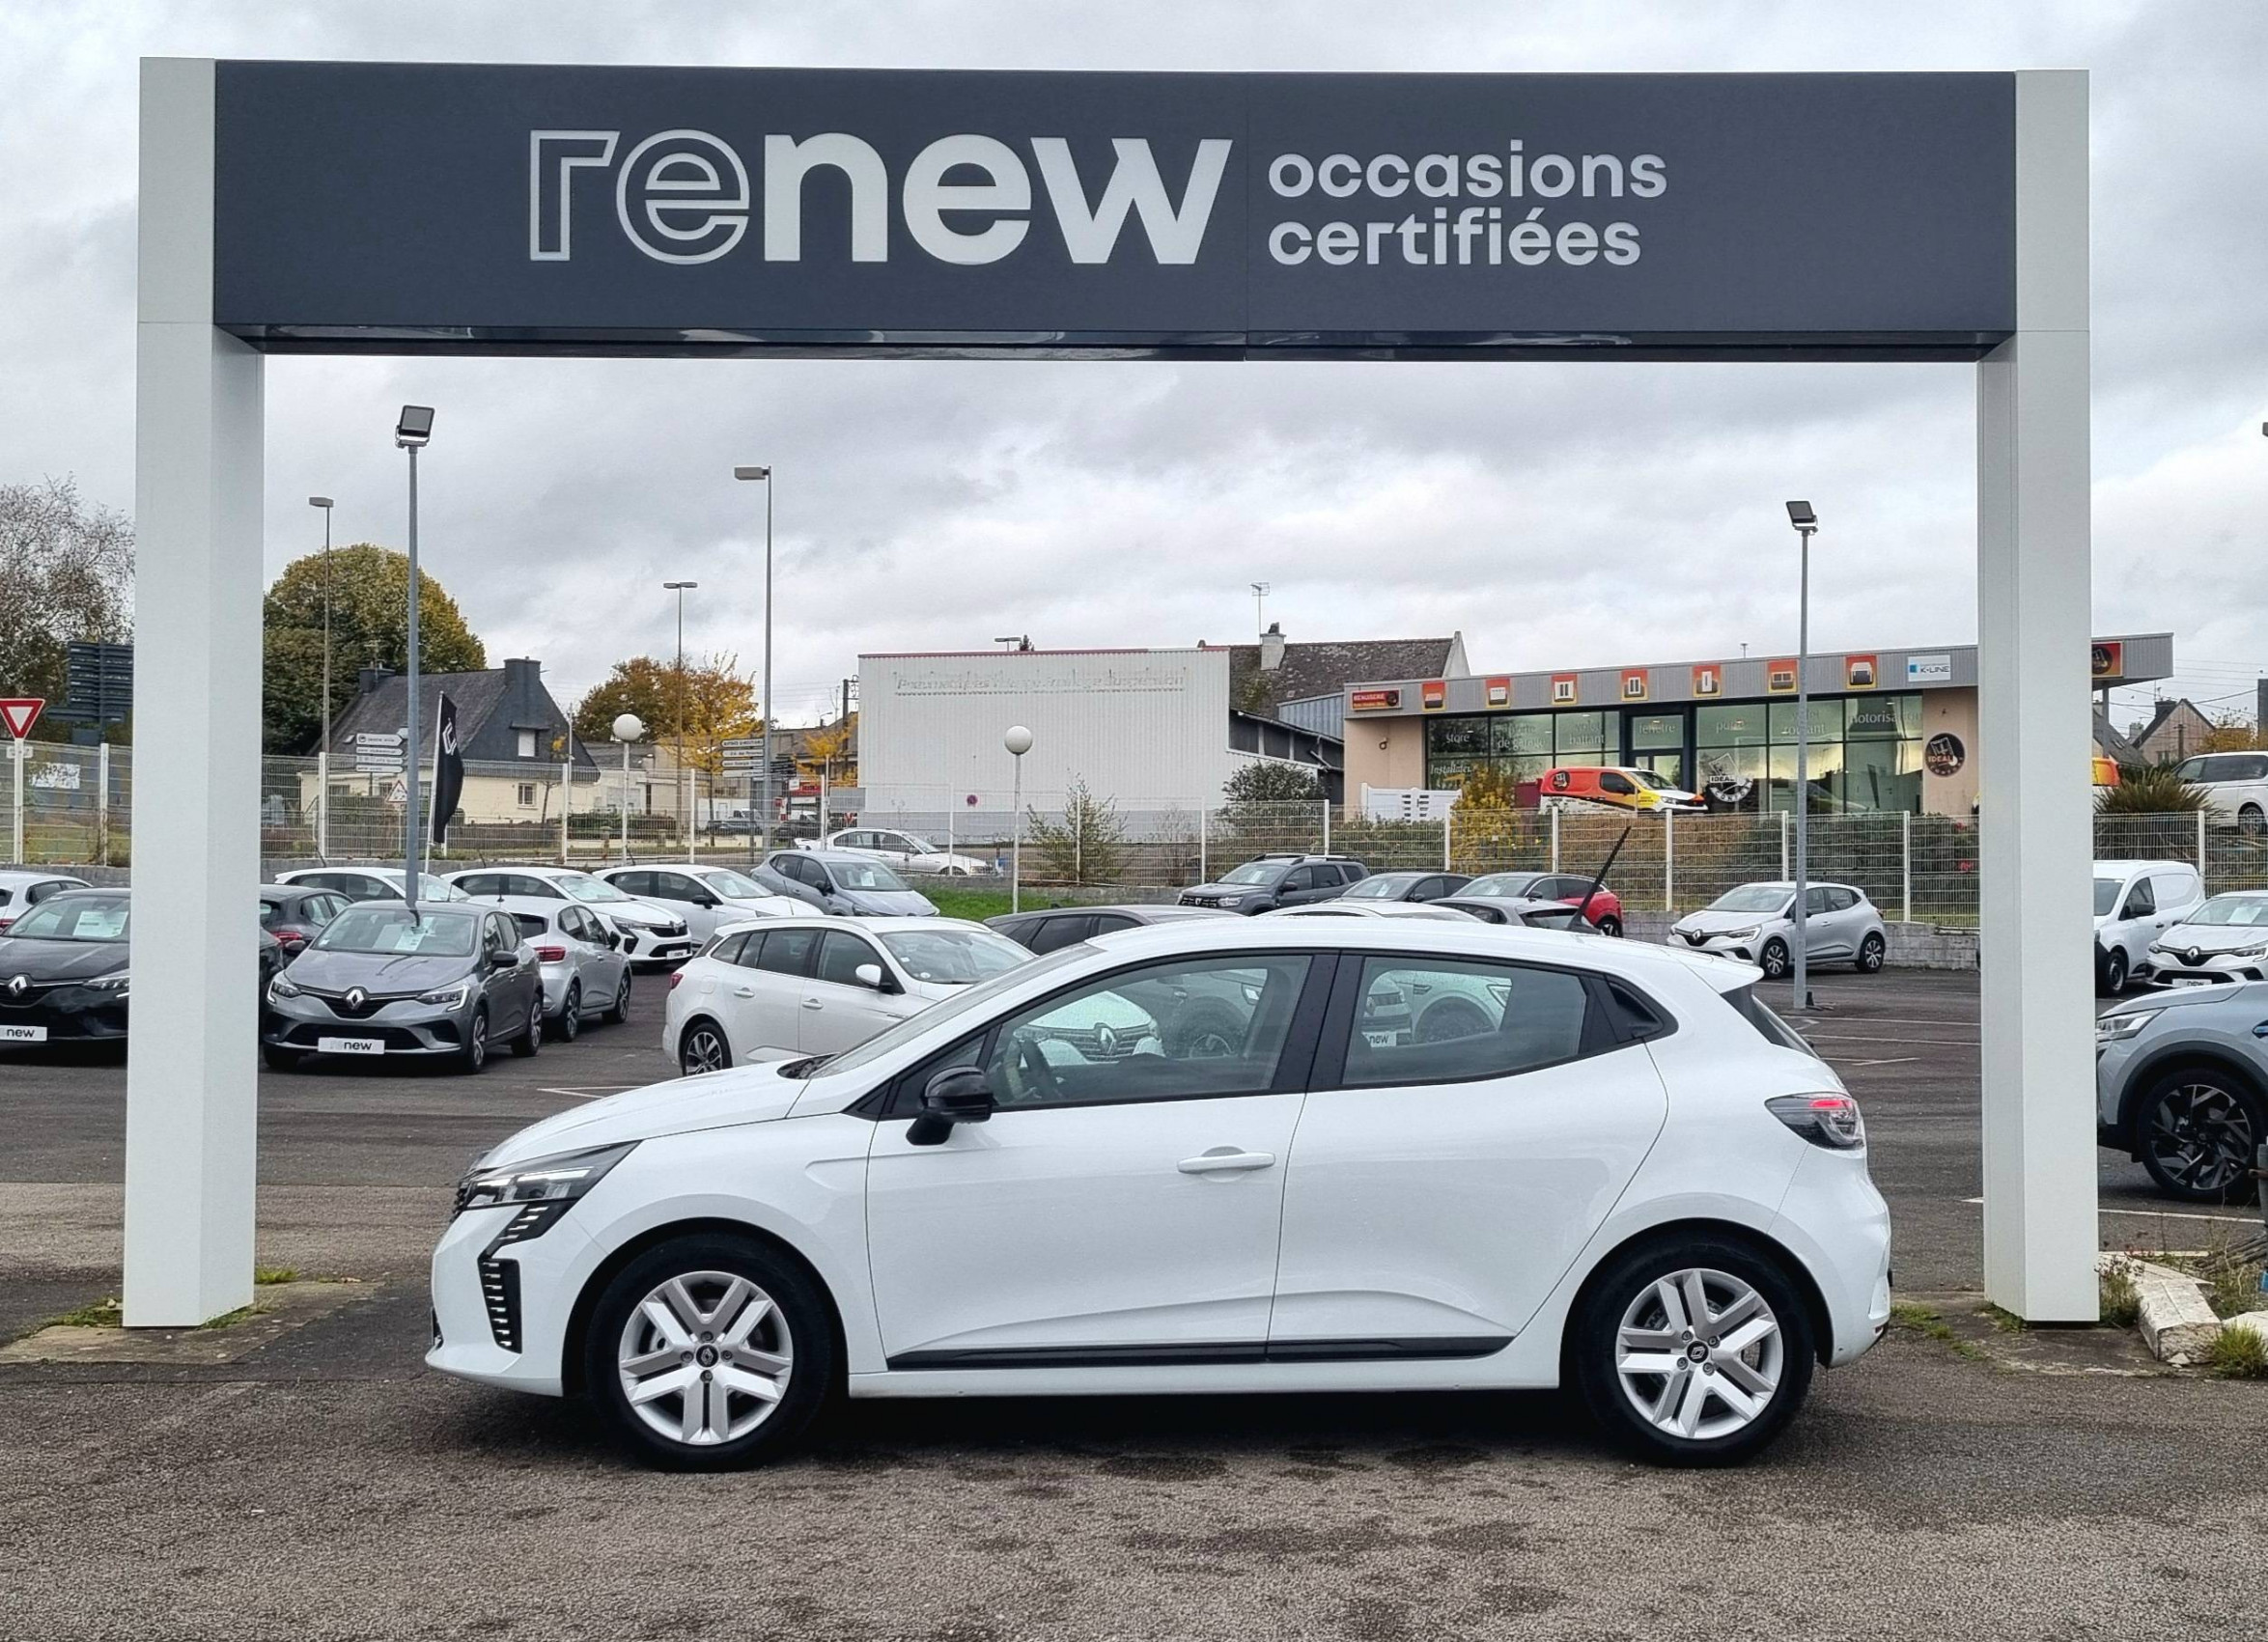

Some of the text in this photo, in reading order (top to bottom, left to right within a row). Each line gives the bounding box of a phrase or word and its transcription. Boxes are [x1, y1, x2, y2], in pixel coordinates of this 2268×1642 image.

[529, 128, 1234, 265] renew
[1268, 139, 1668, 198] occasions
[1268, 206, 1642, 265] certifiées
